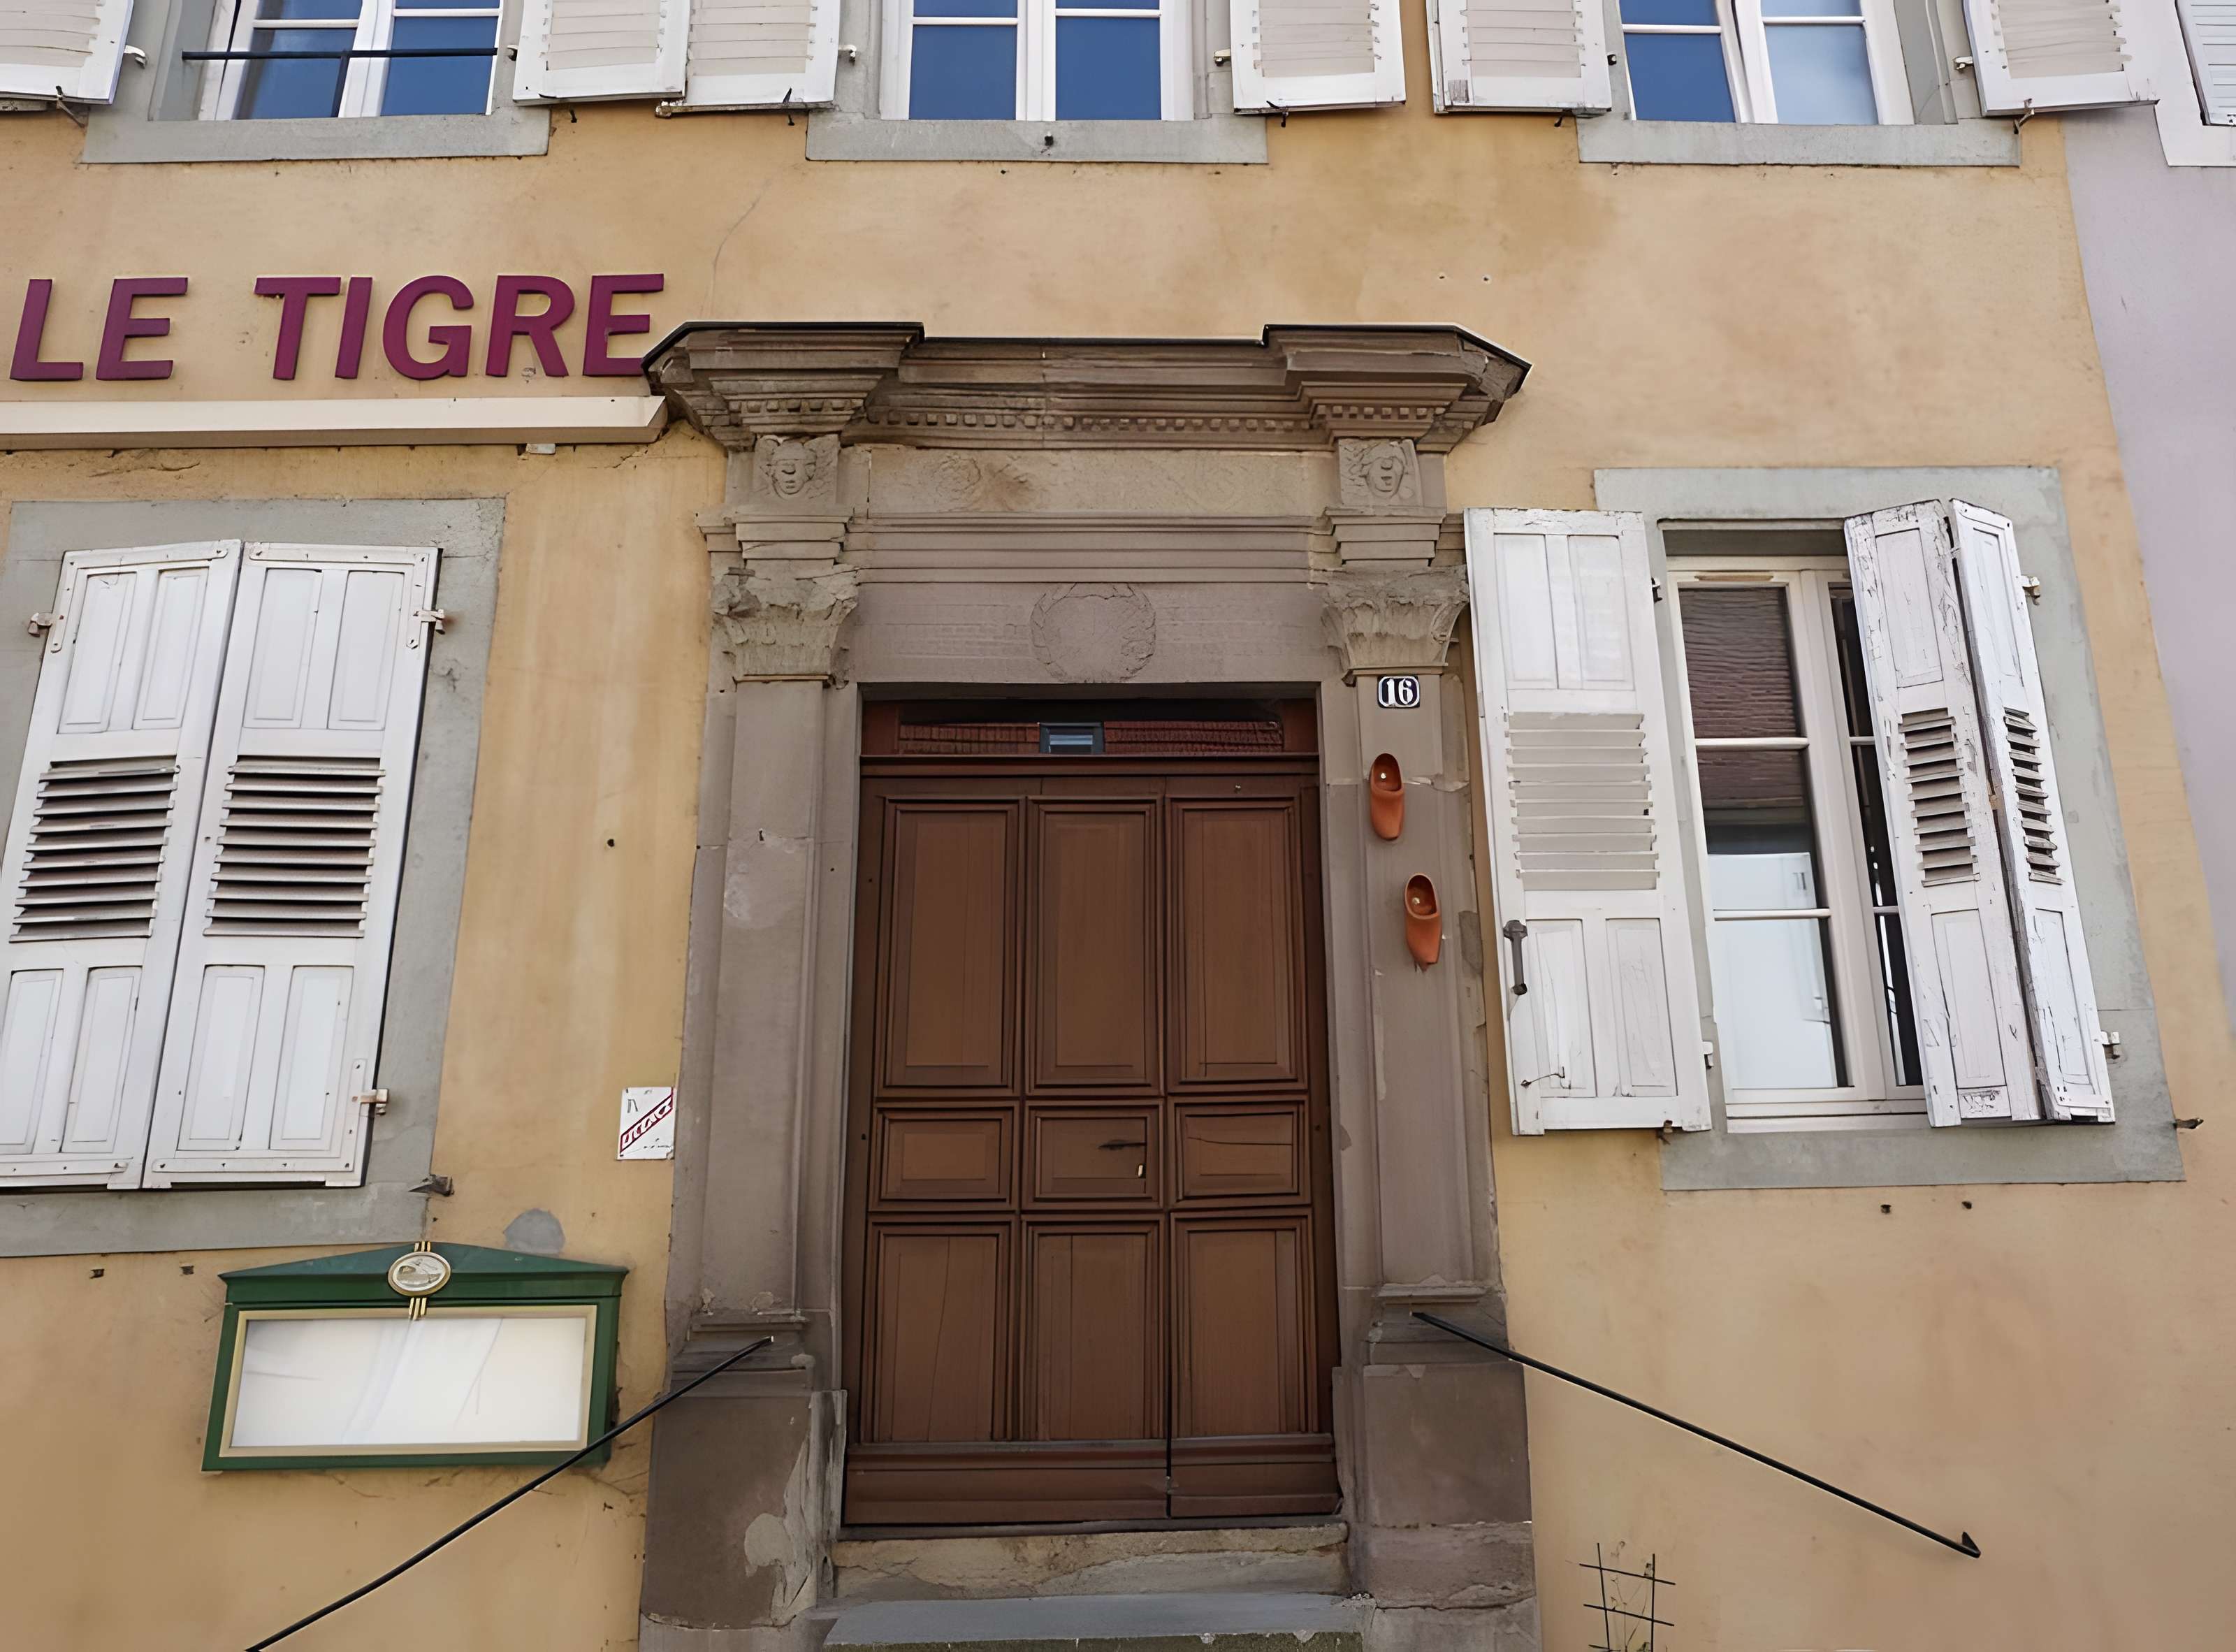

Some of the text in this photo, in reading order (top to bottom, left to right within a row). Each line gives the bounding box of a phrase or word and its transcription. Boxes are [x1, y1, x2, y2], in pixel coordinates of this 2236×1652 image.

[10, 273, 665, 382] LE TIGRE
[1386, 678, 1414, 705] 16
